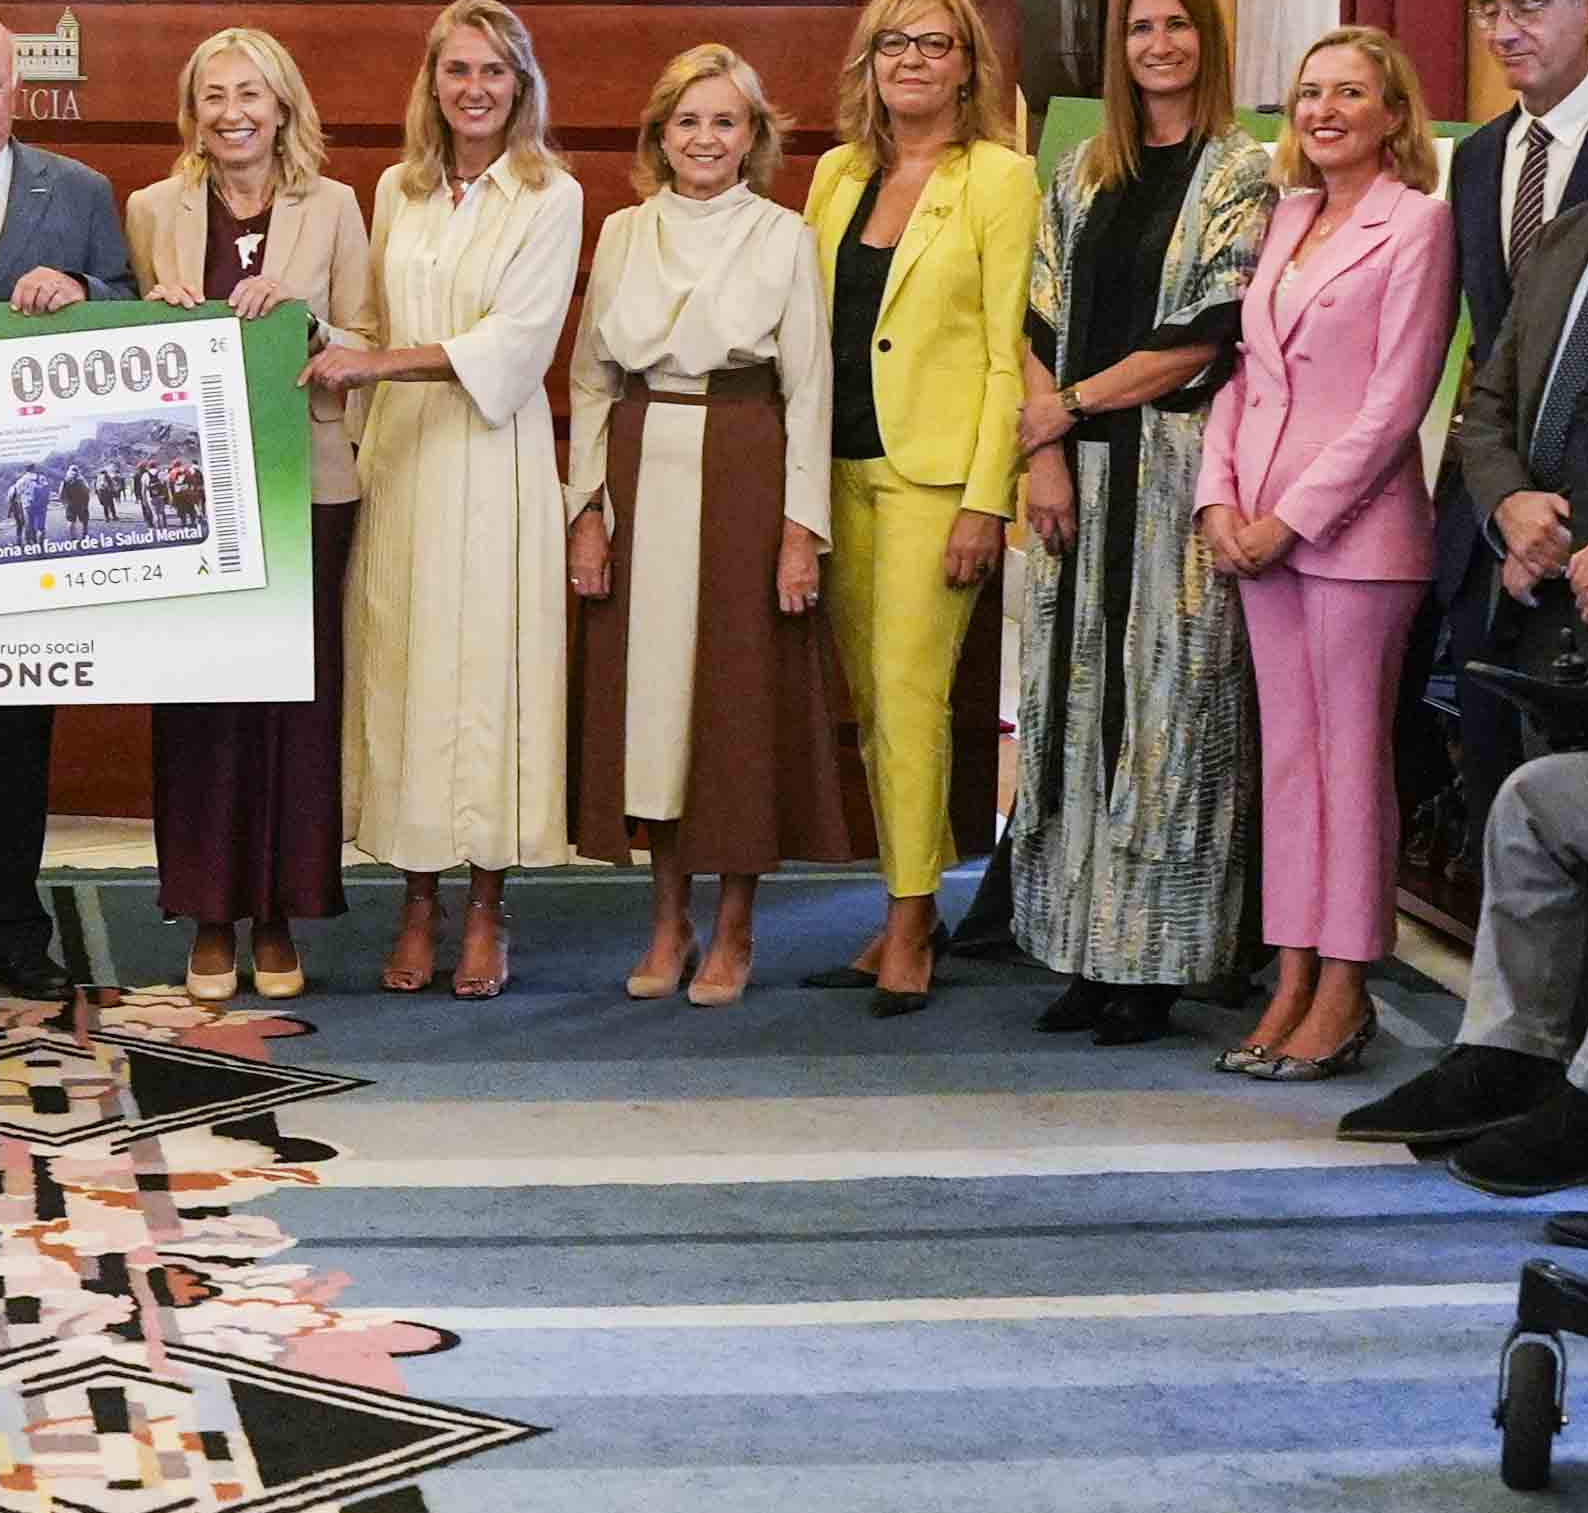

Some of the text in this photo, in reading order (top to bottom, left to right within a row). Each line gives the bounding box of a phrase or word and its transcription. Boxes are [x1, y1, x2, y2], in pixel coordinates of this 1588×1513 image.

[11, 342, 188, 402] 00000
[24, 543, 41, 555] en
[43, 539, 77, 554] favor
[80, 535, 98, 550] de
[100, 534, 113, 547] la
[116, 528, 153, 546] Salud
[156, 524, 203, 542] Mental
[64, 572, 85, 588] 14
[142, 564, 163, 581] 24
[46, 640, 94, 654] social
